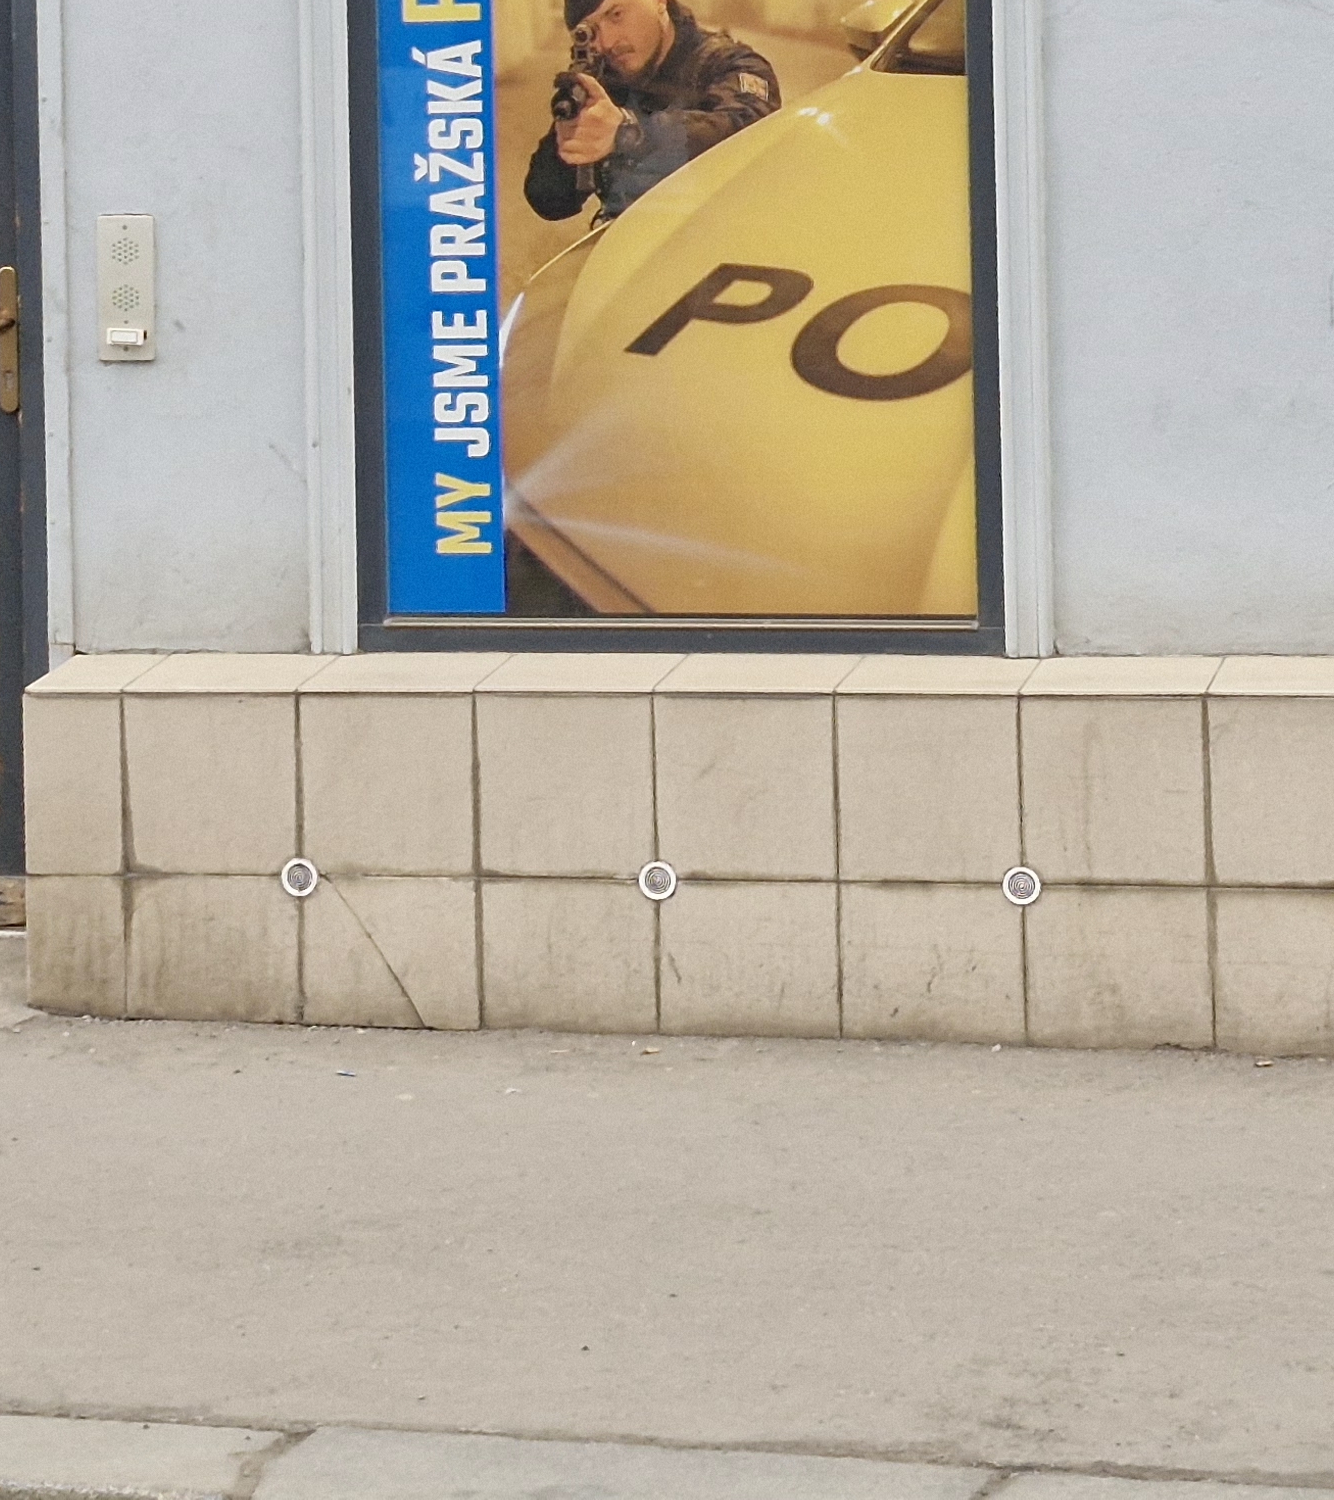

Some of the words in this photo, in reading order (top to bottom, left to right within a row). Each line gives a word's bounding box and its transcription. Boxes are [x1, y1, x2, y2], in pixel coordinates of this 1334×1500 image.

[411, 38, 488, 294] PRAŽSKÁ
[431, 308, 492, 459] JSME
[434, 471, 493, 555] MY
